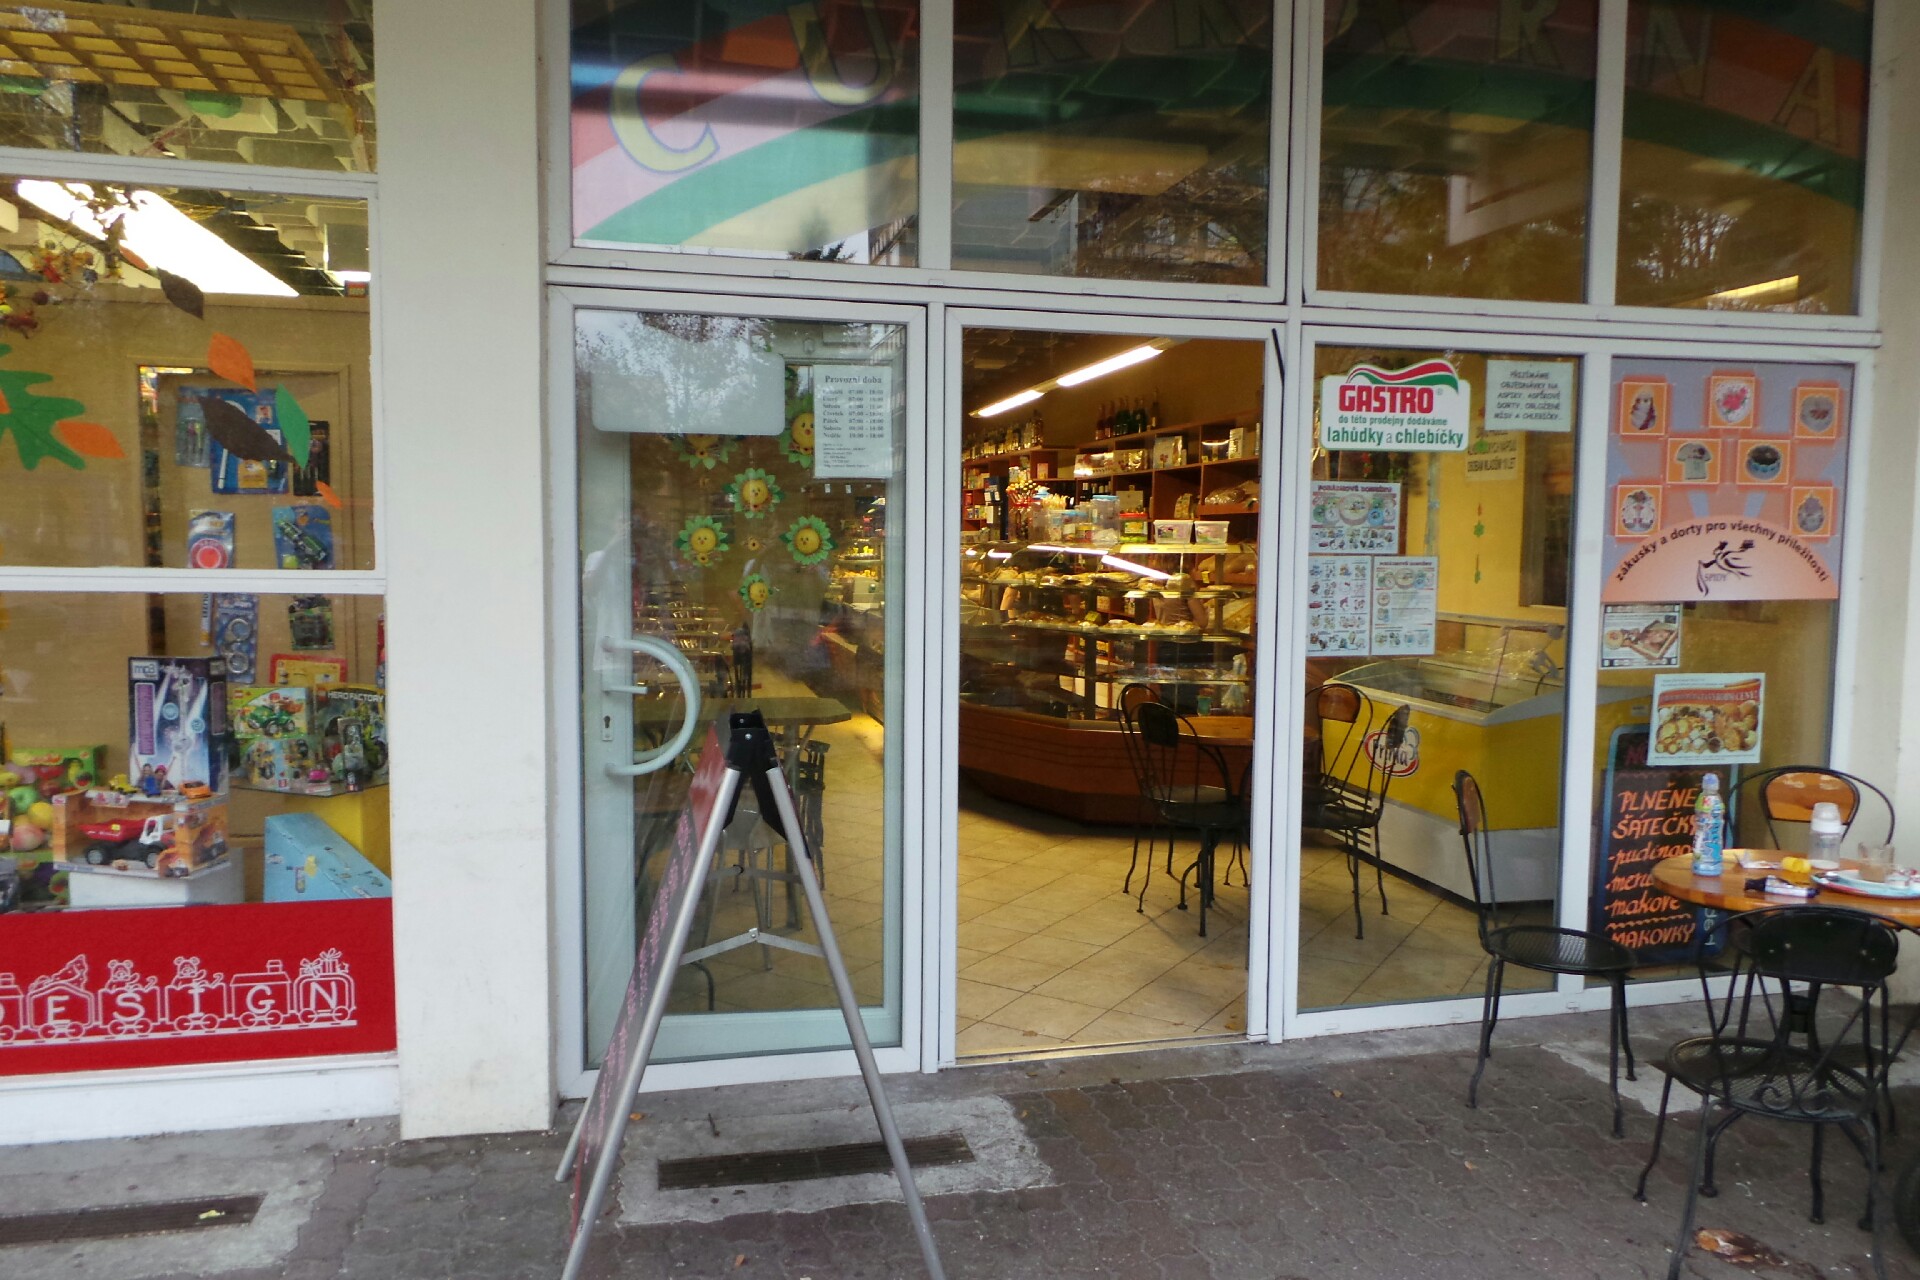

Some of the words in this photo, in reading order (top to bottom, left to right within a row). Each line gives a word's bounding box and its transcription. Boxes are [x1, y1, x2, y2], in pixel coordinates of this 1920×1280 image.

[1339, 385, 1434, 414] GASTRO
[1339, 415, 1349, 424] do
[1351, 415, 1367, 424] této
[1369, 416, 1405, 427] prodejny
[1407, 416, 1447, 426] dodáváme
[1327, 427, 1384, 446] lahůdky
[1386, 432, 1392, 444] a
[1395, 427, 1464, 449] chlebíčky
[1660, 537, 1668, 545] a
[1670, 525, 1702, 540] dorty
[1706, 522, 1727, 534] pro
[1731, 520, 1777, 540] všechny
[0, 982, 338, 1026] ESIGN
